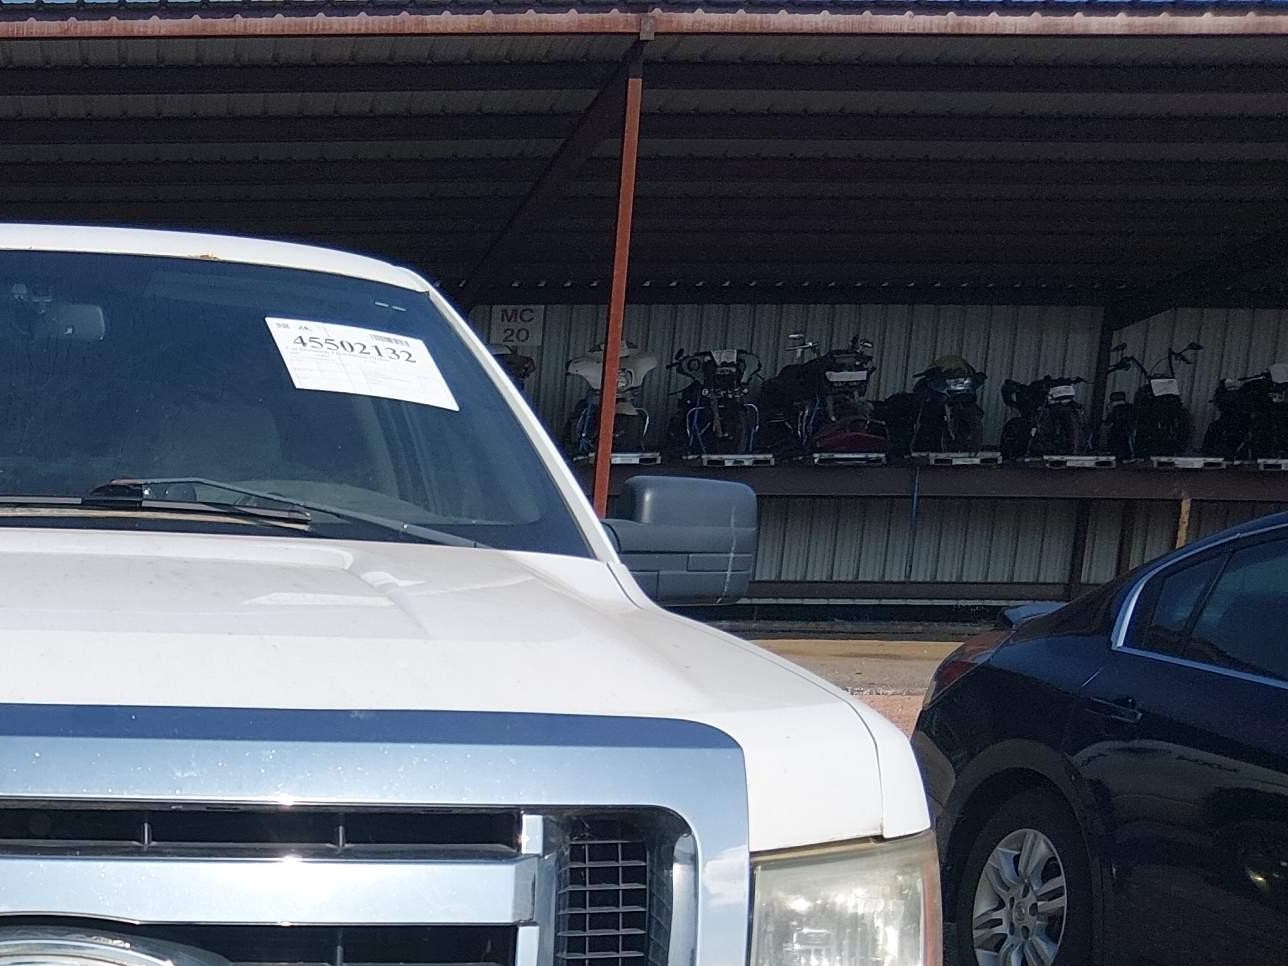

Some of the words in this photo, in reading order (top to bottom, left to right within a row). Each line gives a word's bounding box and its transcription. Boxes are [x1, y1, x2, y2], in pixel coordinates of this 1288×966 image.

[501, 308, 534, 322] MC
[502, 327, 529, 343] 20
[292, 334, 417, 364] 45502132
